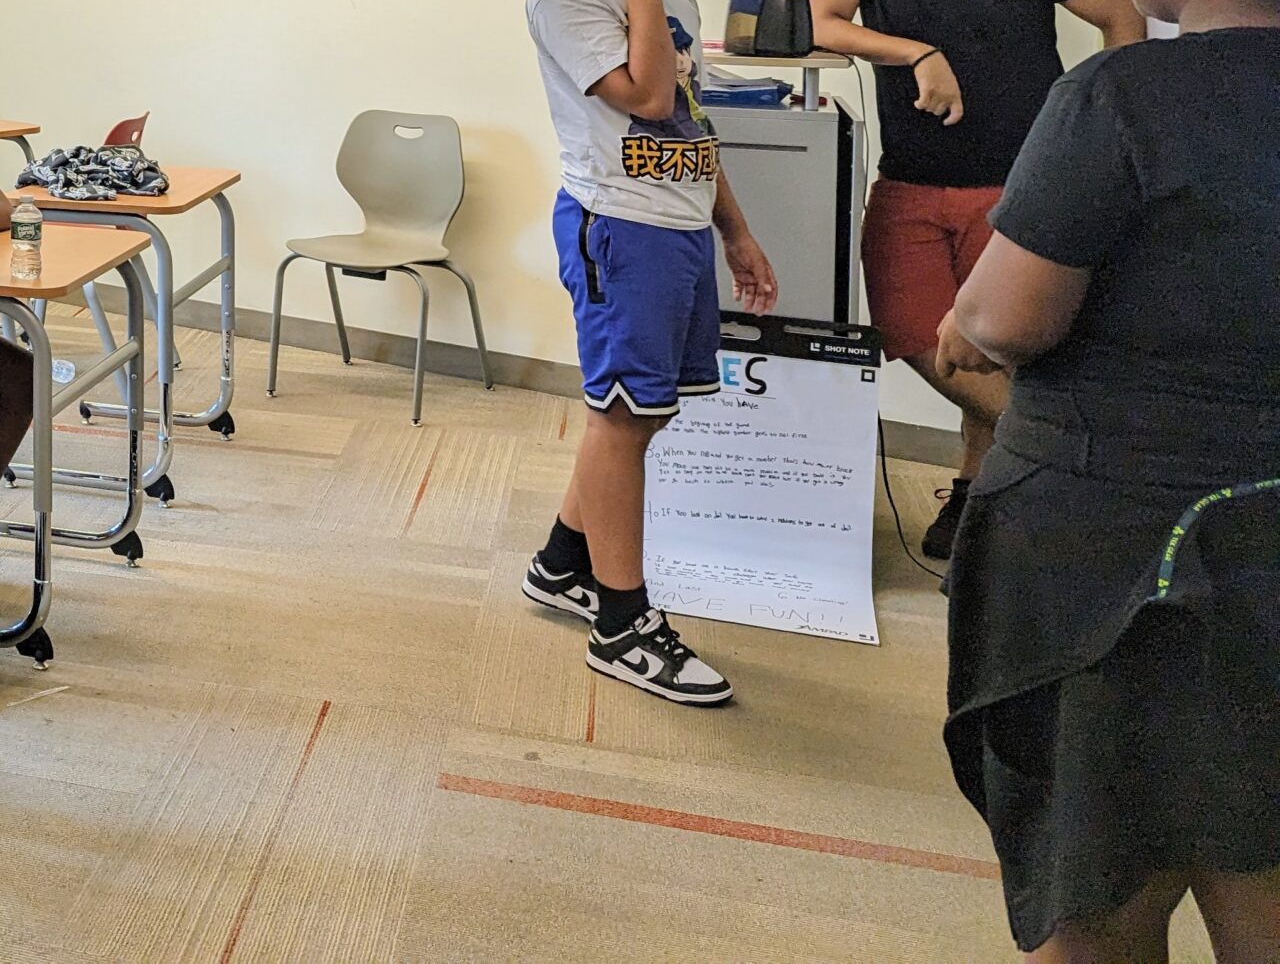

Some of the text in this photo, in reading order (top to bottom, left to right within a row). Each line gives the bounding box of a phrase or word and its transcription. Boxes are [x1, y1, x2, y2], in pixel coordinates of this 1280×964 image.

[824, 344, 871, 356] SHOT NOTE
[662, 446, 684, 457] When
